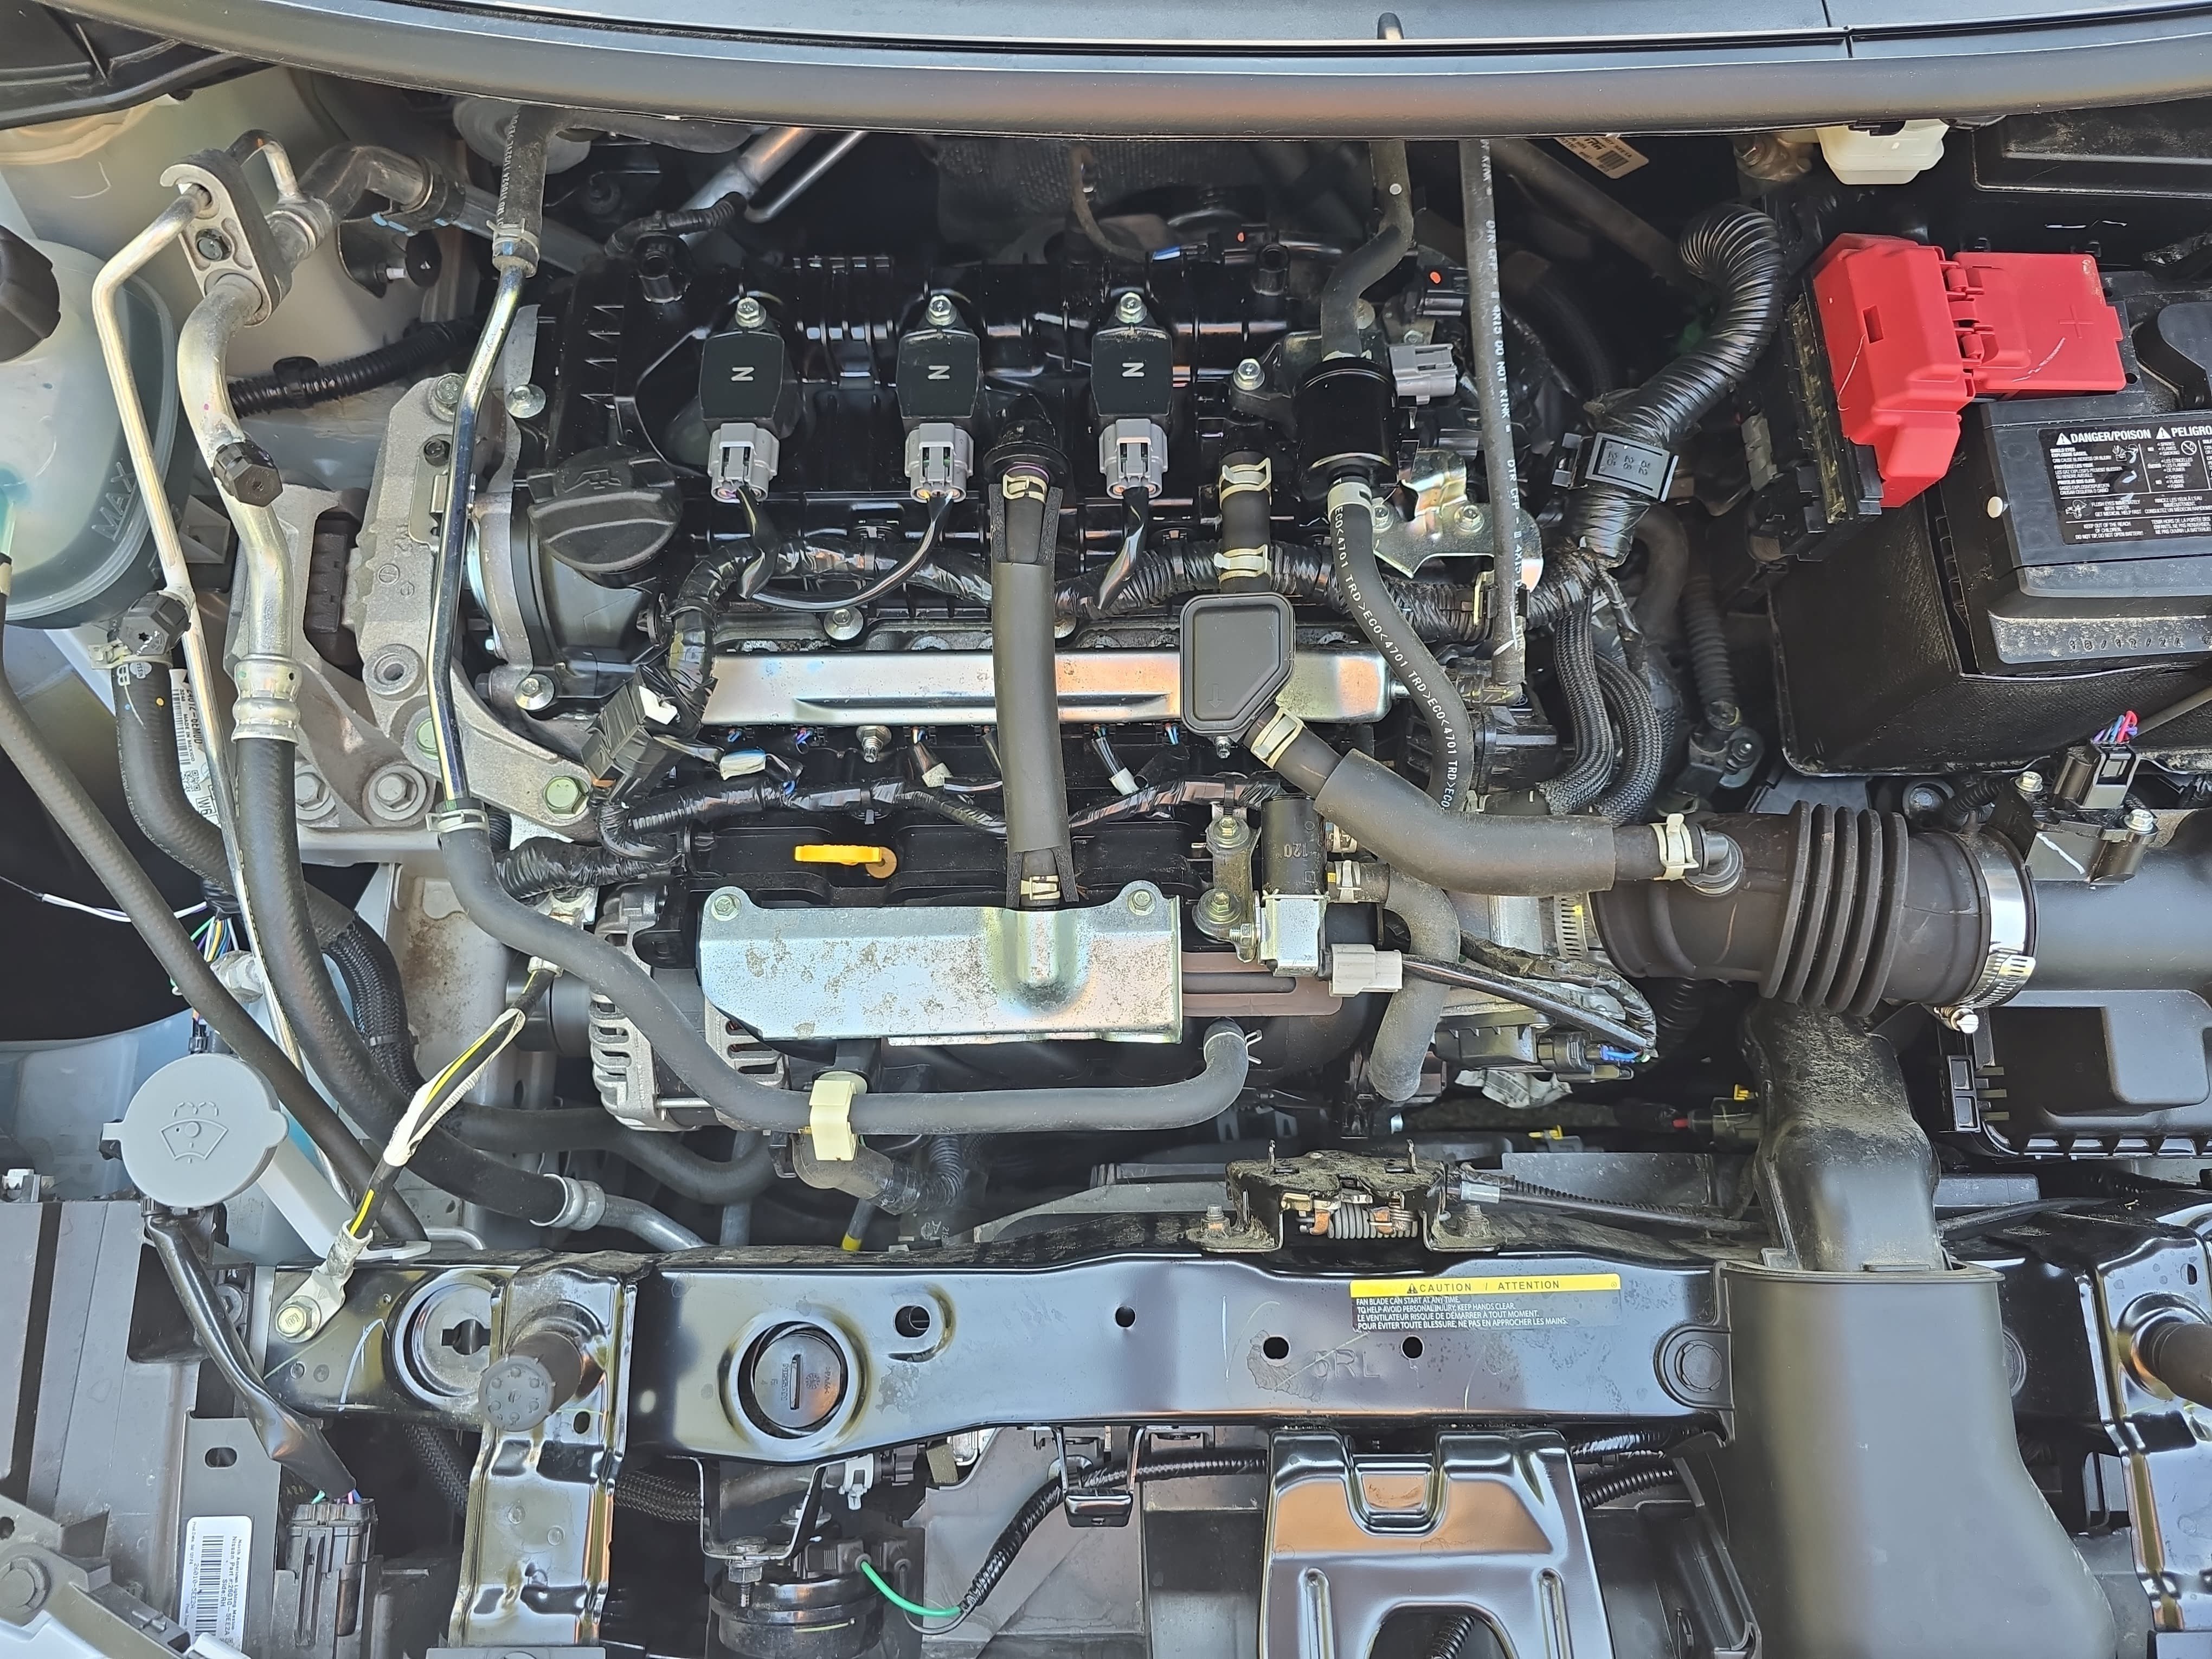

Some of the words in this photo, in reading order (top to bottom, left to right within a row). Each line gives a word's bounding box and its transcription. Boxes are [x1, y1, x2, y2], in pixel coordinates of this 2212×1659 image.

[2070, 429, 2151, 443] DANGER/POISON
[92, 461, 137, 540] MAX
[1419, 1283, 1471, 1293] CAUTION
[1498, 1280, 1560, 1290] ATTENTION
[1356, 1298, 1369, 1306] FAN
[1369, 1297, 1388, 1306] BLADE
[1404, 1296, 1422, 1304] START
[1403, 1304, 1435, 1313] PERSONAL
[1457, 1303, 1472, 1311] KEEP
[1473, 1303, 1494, 1311] HANDS
[1366, 1313, 1410, 1321] VENTILATEUR
[1410, 1312, 1435, 1320] RISQUE
[1445, 1310, 1481, 1319] DÉMARRER
[1482, 1309, 1488, 1318] À
[1378, 1320, 1400, 1329] ÉVITER
[1423, 1320, 1457, 1328] BLESSURE,
[1493, 1317, 1532, 1326] APPROCHER
[1533, 1317, 1544, 1326] LES
[1545, 1317, 1568, 1325] MAINS.
[781, 1362, 789, 1401] NISSAN
[229, 1536, 237, 1559] Nissan
